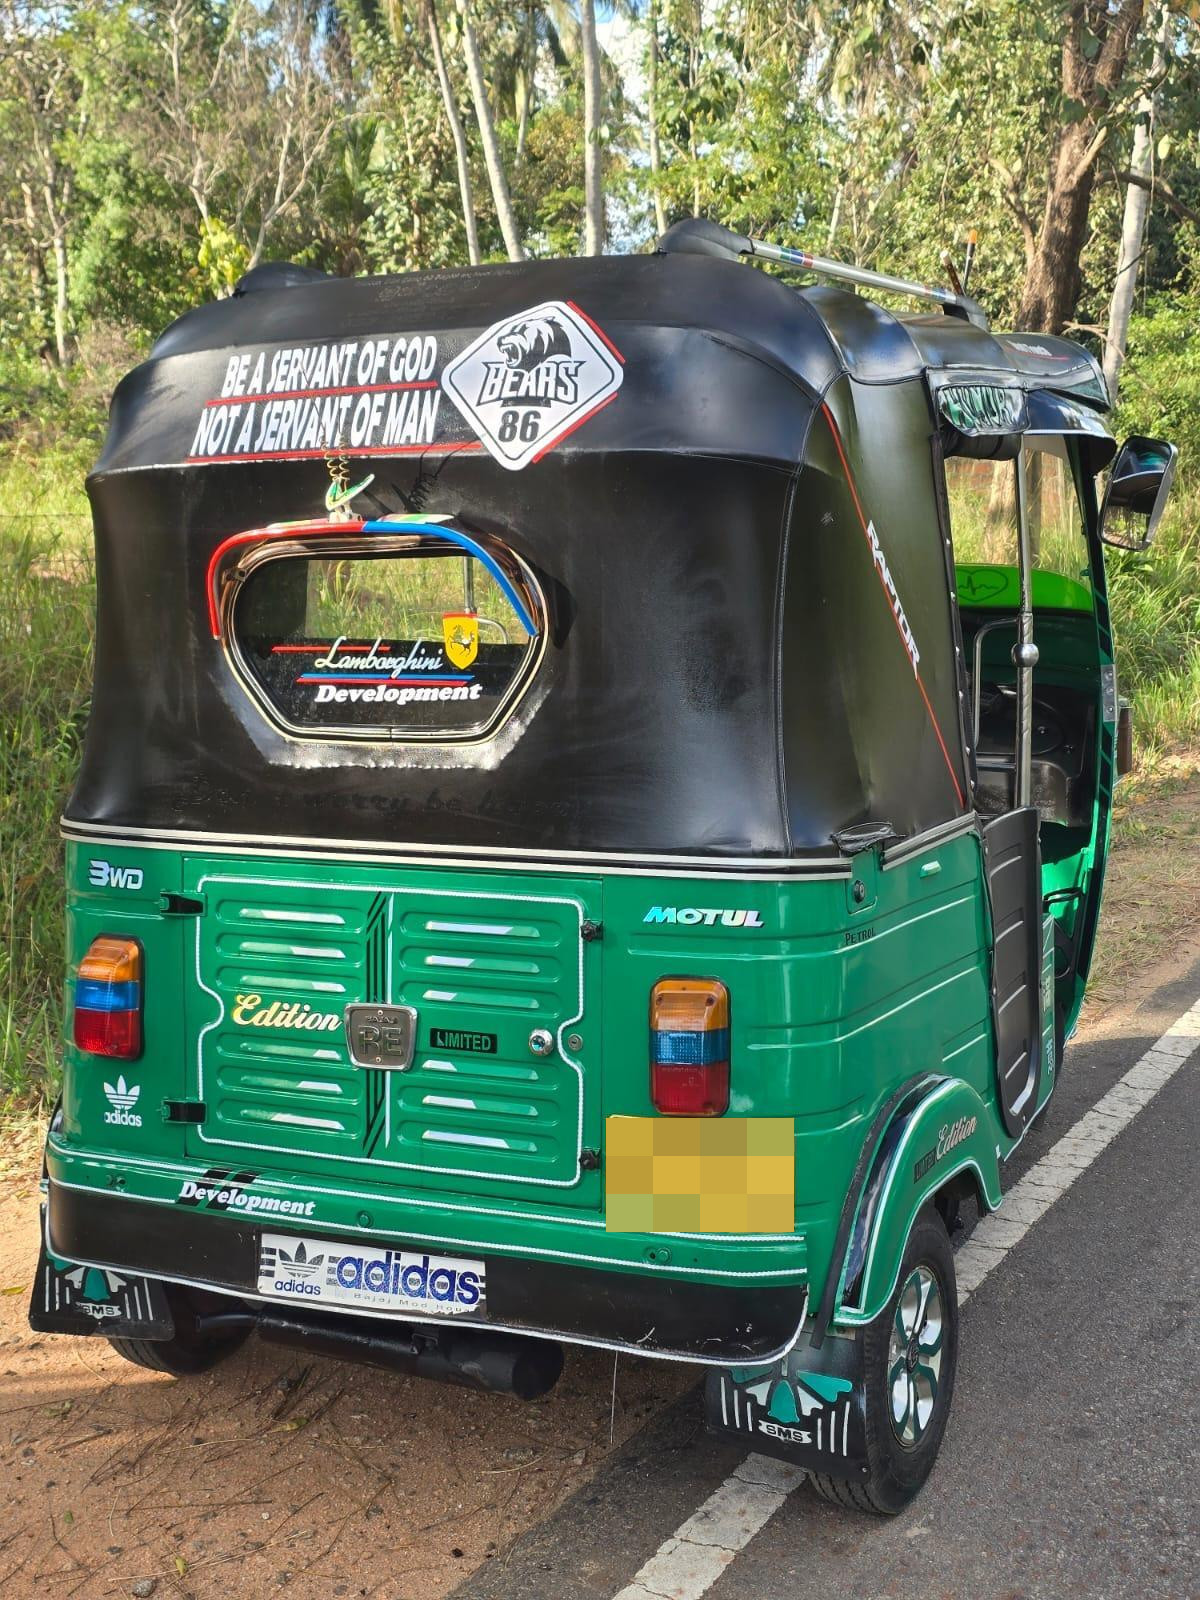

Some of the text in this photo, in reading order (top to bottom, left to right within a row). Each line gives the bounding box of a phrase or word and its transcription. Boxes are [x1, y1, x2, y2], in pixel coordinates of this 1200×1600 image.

[221, 335, 438, 398] BE A SERVANT OF GOD
[476, 360, 587, 407] BEARS
[189, 389, 441, 457] NOT A SERVANT OF MAN
[498, 410, 541, 443] 86
[314, 635, 444, 680] Lamborghini
[314, 684, 483, 706] Development
[88, 859, 144, 890] 3WD
[642, 906, 764, 928] MOTUL
[232, 994, 343, 1031] Edition
[358, 1025, 402, 1057] RE
[435, 1031, 492, 1051] LIMITED
[103, 1109, 142, 1127] adidas
[936, 1116, 977, 1160] Edition
[178, 1181, 317, 1216] Development
[274, 1279, 321, 1296] adidas
[337, 1251, 480, 1305] adidas
[766, 1424, 803, 1443] SMS
